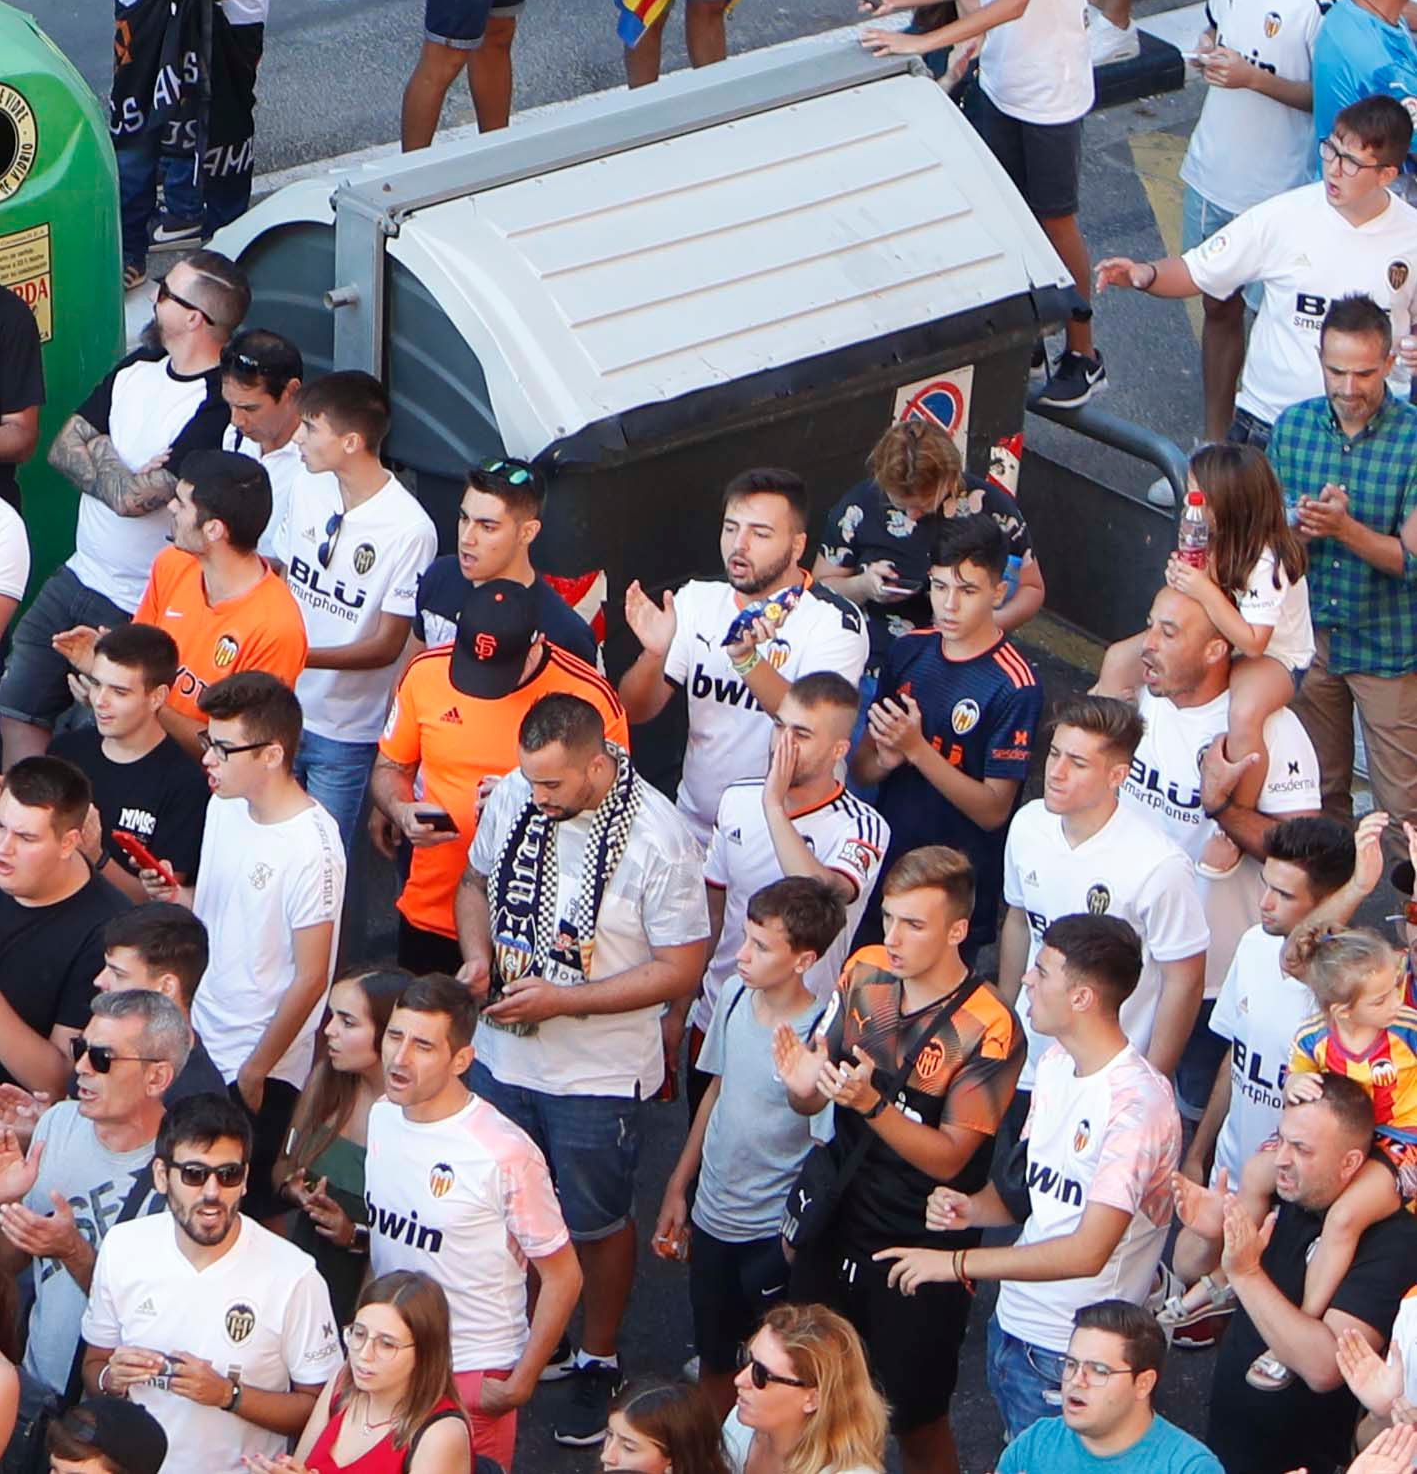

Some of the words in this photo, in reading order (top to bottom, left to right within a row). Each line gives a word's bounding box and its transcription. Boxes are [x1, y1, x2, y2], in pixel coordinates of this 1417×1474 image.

[289, 555, 366, 610] BLÜ
[1128, 757, 1202, 812] BLÜ
[1027, 1160, 1084, 1208] win
[366, 1189, 444, 1253] bwin
